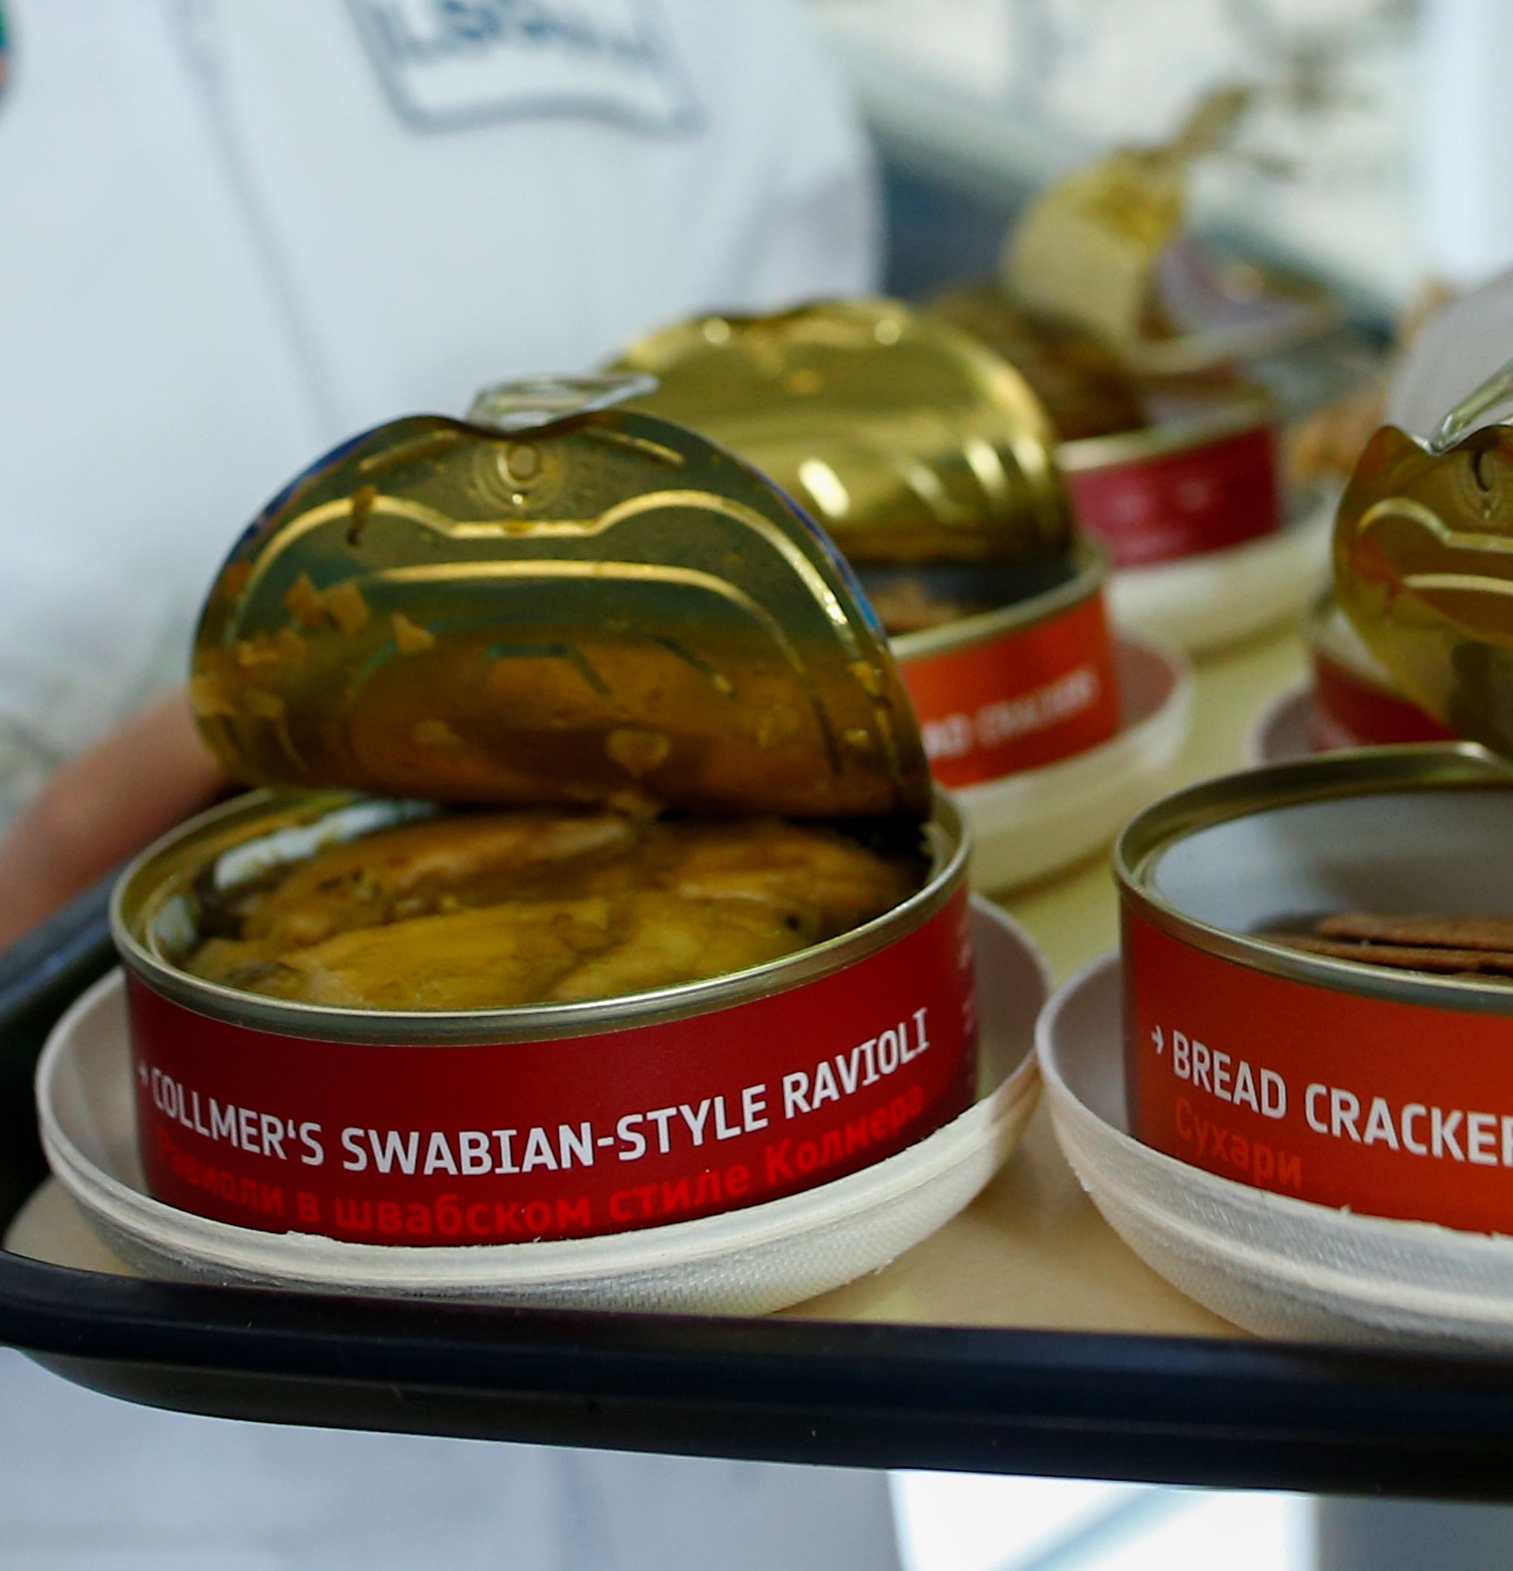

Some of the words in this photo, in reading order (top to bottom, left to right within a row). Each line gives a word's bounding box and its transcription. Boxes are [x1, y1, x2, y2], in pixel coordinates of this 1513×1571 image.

[341, 1083, 769, 1176] SWABIAN-STYLE
[782, 1007, 931, 1119] RAVIOLI
[1172, 1029, 1287, 1119] BREAD
[296, 1190, 321, 1224] в
[335, 1191, 591, 1236] швабском
[608, 1162, 751, 1222] стиле
[764, 1084, 925, 1185] Колмера
[1174, 1095, 1304, 1190] Сухари
